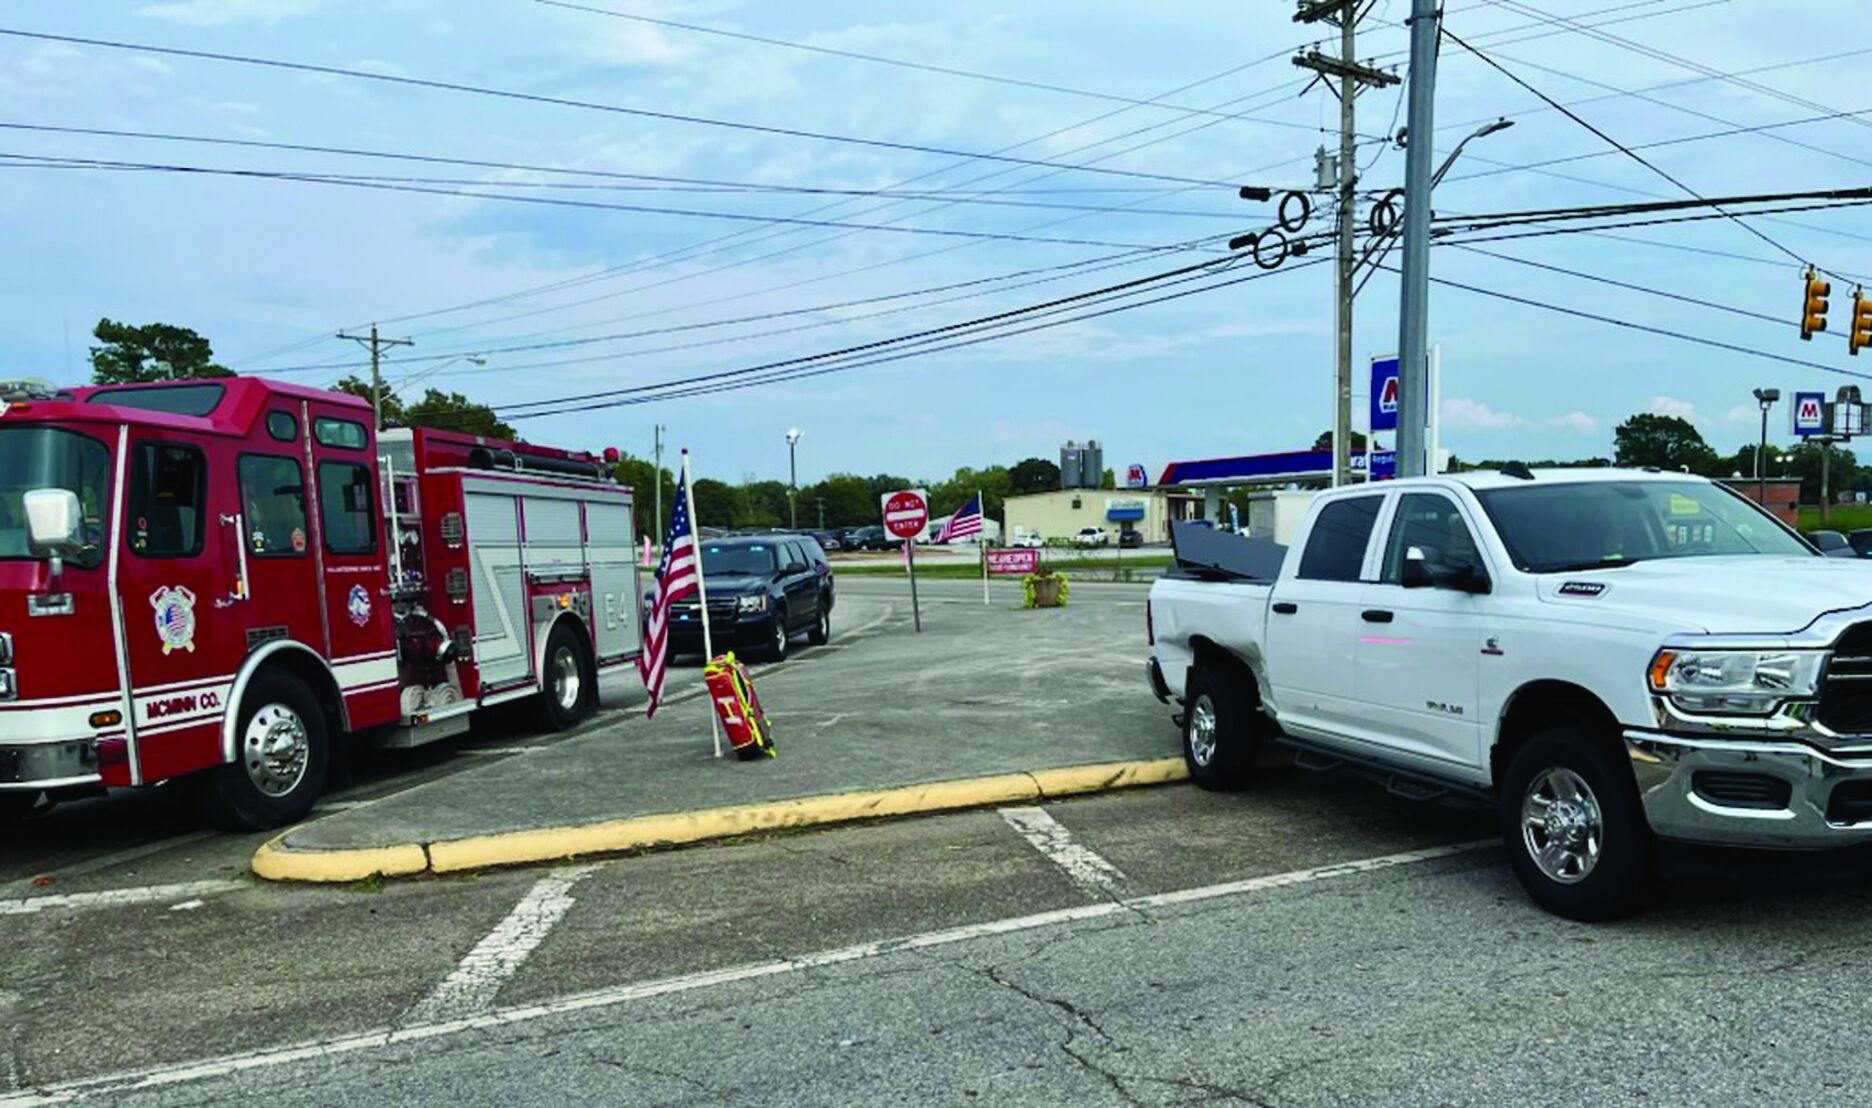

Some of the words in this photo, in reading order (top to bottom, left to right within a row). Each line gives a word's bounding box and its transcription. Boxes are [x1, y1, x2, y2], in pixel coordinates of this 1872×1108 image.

[1801, 403, 1818, 418] M
[888, 502, 900, 511] DO
[904, 499, 919, 508] NOT
[603, 593, 629, 631] E4
[200, 691, 221, 709] CO.
